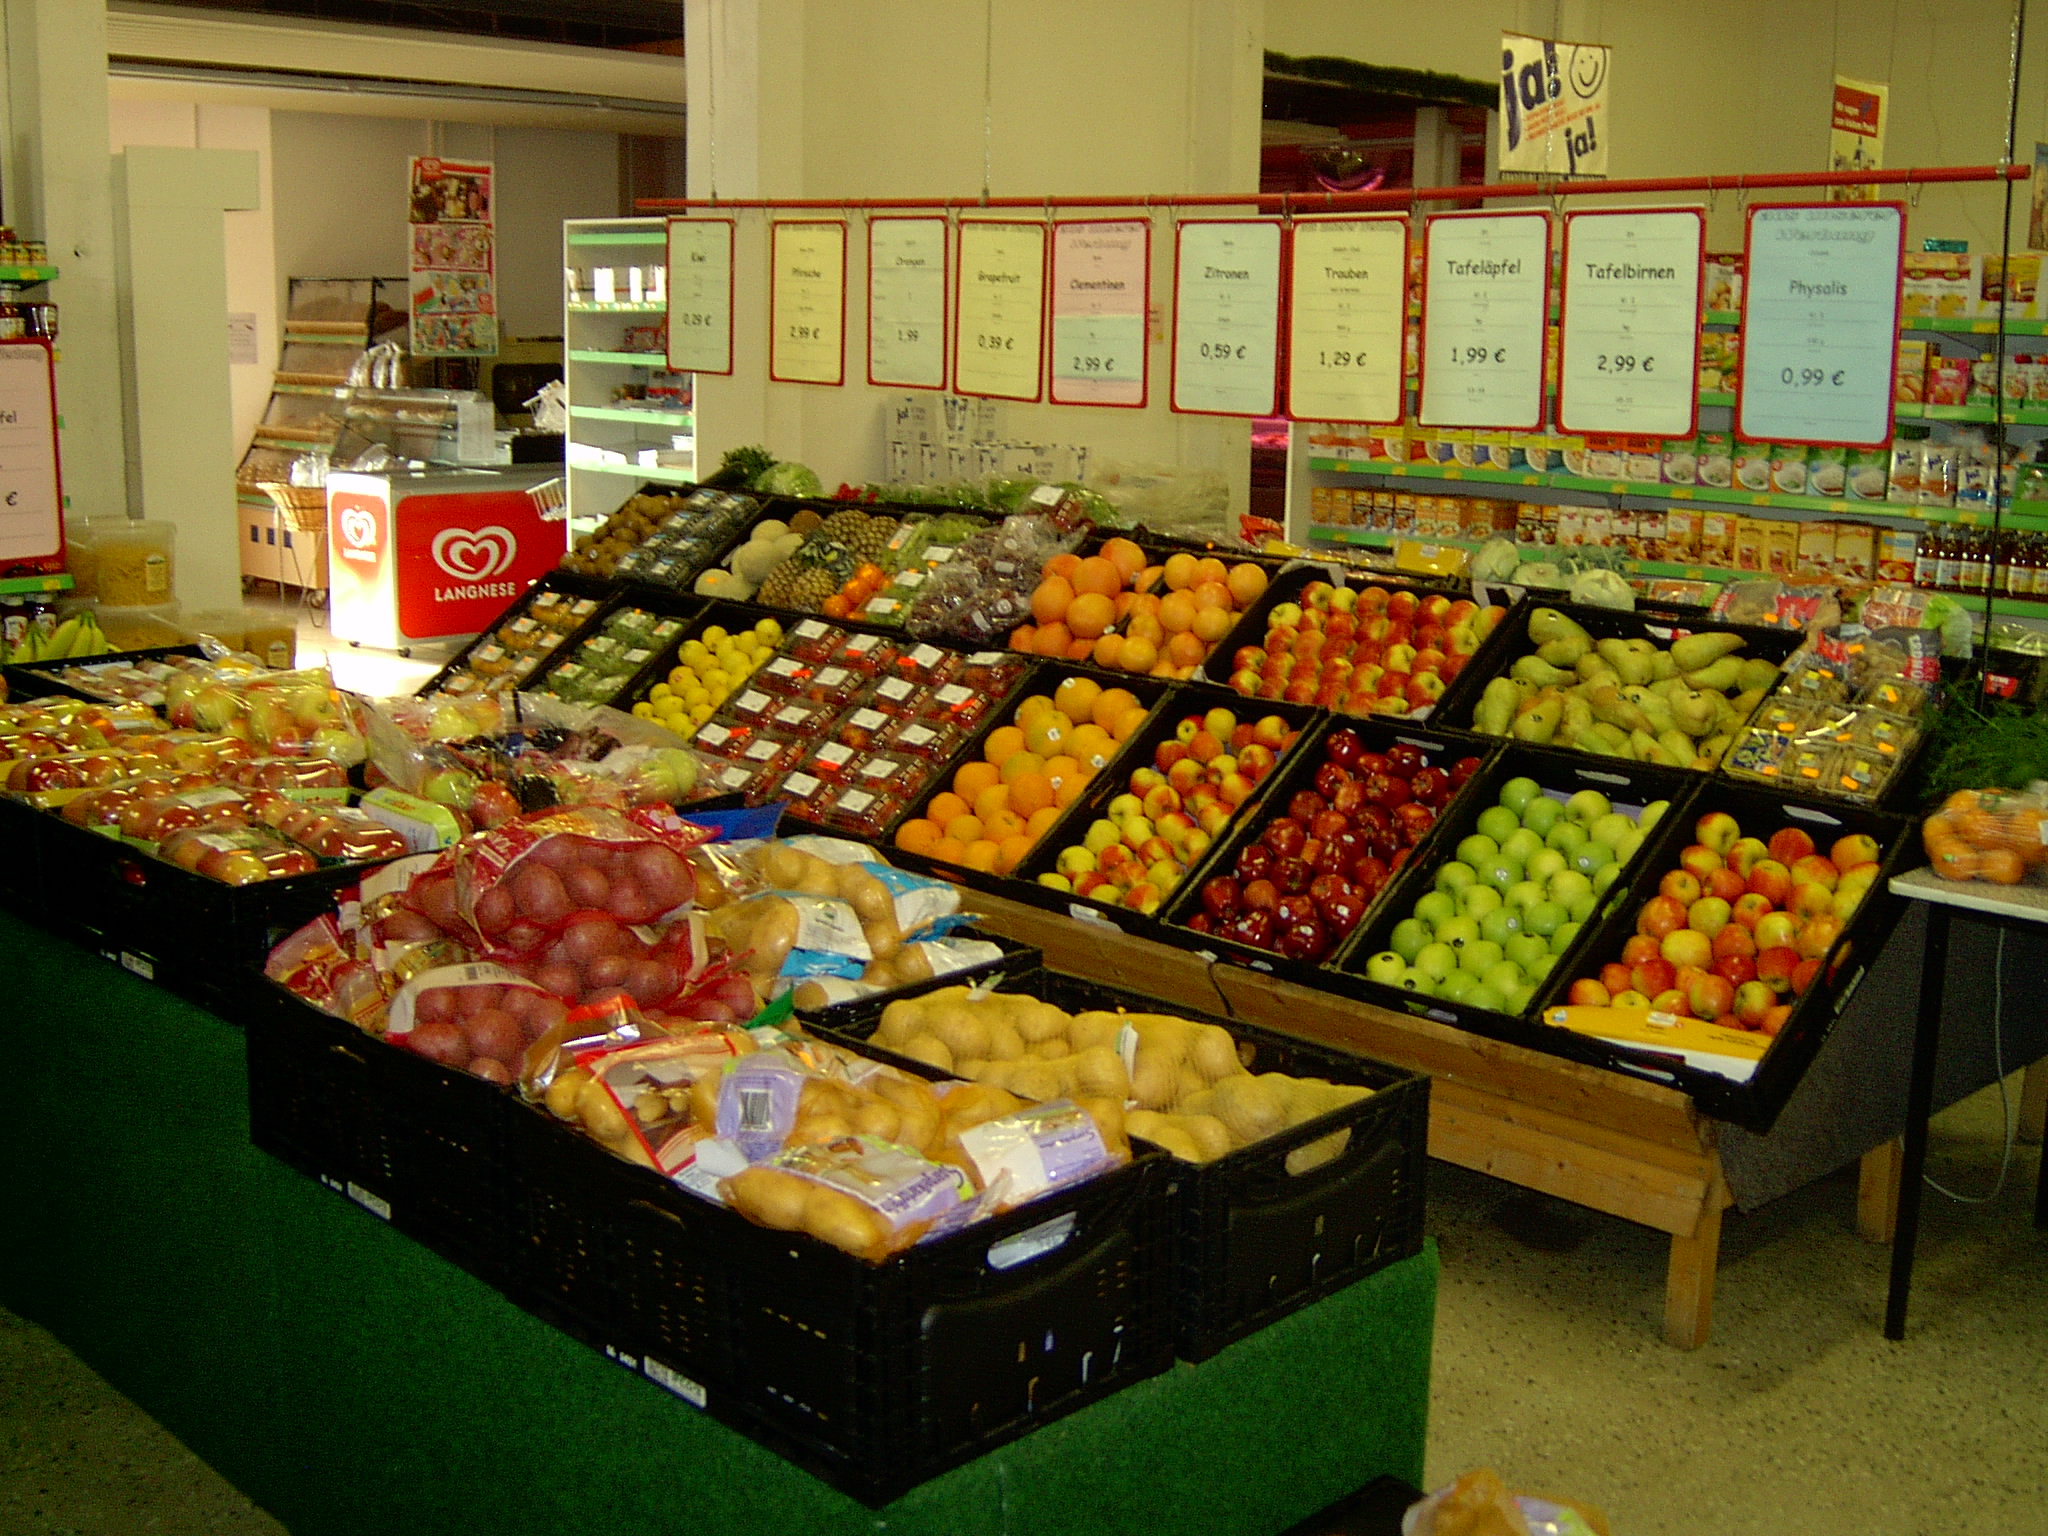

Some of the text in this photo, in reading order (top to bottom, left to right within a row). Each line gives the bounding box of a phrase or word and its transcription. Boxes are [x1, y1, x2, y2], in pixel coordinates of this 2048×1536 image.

[1502, 41, 1561, 151] ja!
[1565, 117, 1597, 174] ja!
[1204, 265, 1250, 280] Zitronen
[1324, 266, 1369, 280] Trauben
[1447, 258, 1521, 279] Tafeläpfel
[1585, 262, 1675, 280] Tafelbirnen
[1789, 279, 1848, 299] Physalis
[1004, 337, 1014, 351] €
[1200, 342, 1247, 361] 0,59 €
[1073, 356, 1115, 373] 2,99 €
[1320, 351, 1367, 368] 1,29 €
[1451, 347, 1506, 367] 1,99 €
[1597, 354, 1655, 374] 2,99 €
[1781, 367, 1845, 387] 0,99 €
[6, 491, 18, 506] €
[433, 582, 516, 602] LANGNESE
